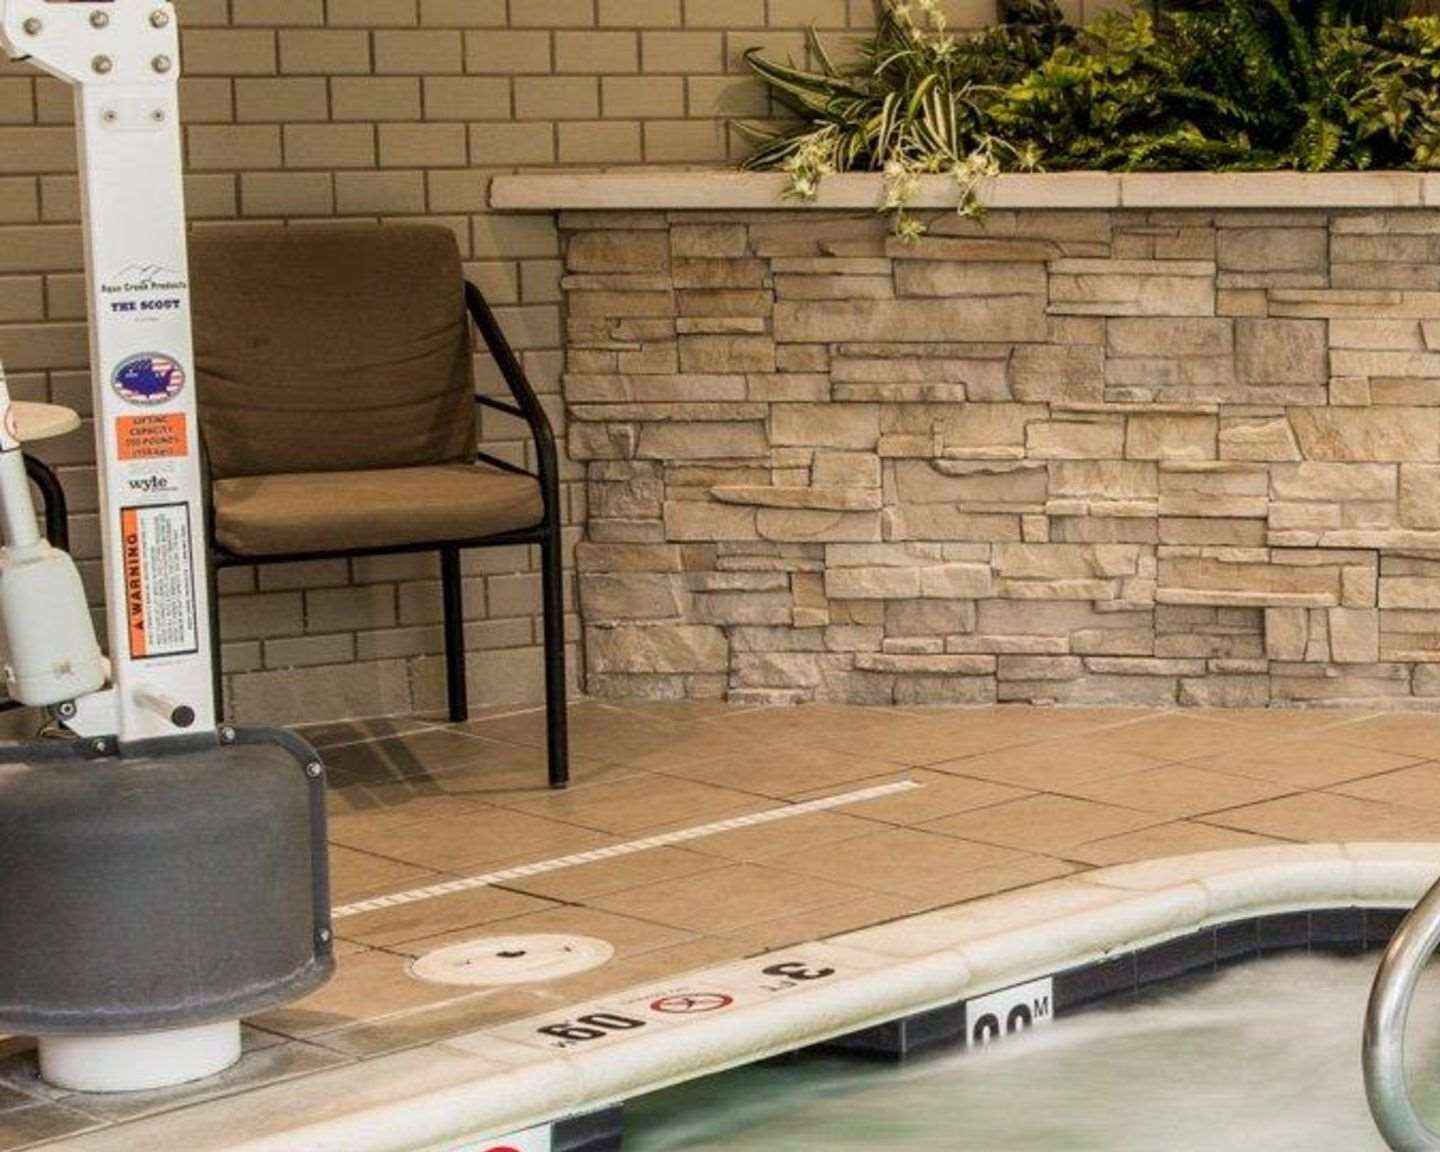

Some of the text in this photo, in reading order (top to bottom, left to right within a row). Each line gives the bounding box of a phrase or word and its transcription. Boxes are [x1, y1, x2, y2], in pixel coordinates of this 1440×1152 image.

[111, 299, 180, 312] THE SCOUT
[127, 533, 143, 616] WARNING
[762, 961, 836, 981] 3
